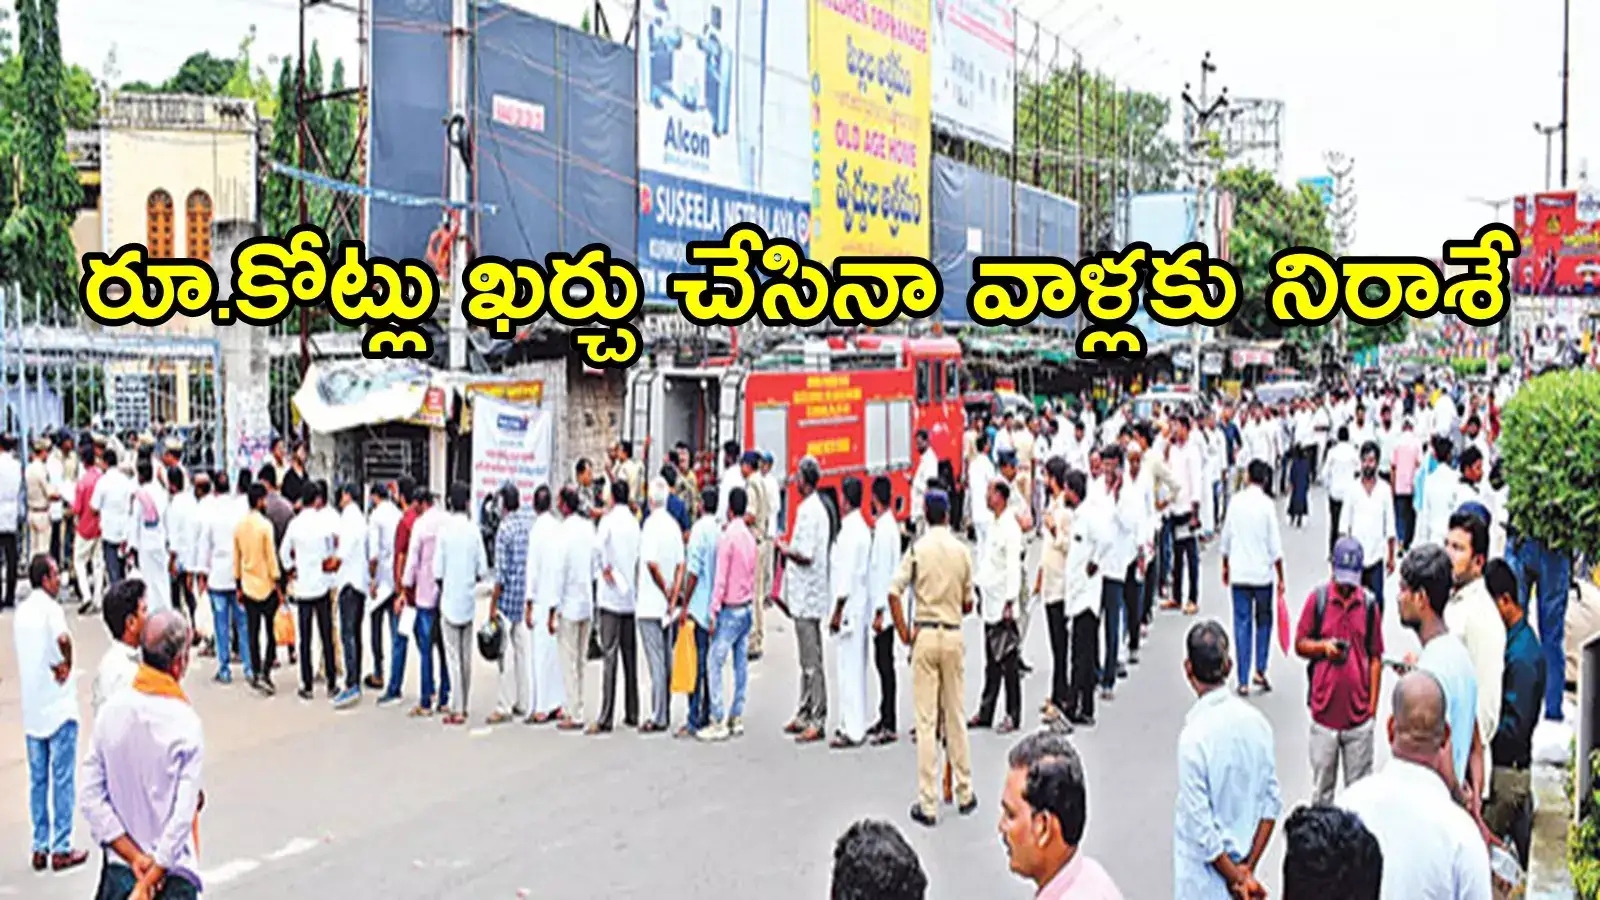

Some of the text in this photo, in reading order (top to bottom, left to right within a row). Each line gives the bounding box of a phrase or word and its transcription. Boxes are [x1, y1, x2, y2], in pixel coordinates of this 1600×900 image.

[663, 115, 710, 159] Alcon
[834, 118, 917, 168] OLD AGE HOME
[655, 183, 721, 234] SUSEELA
